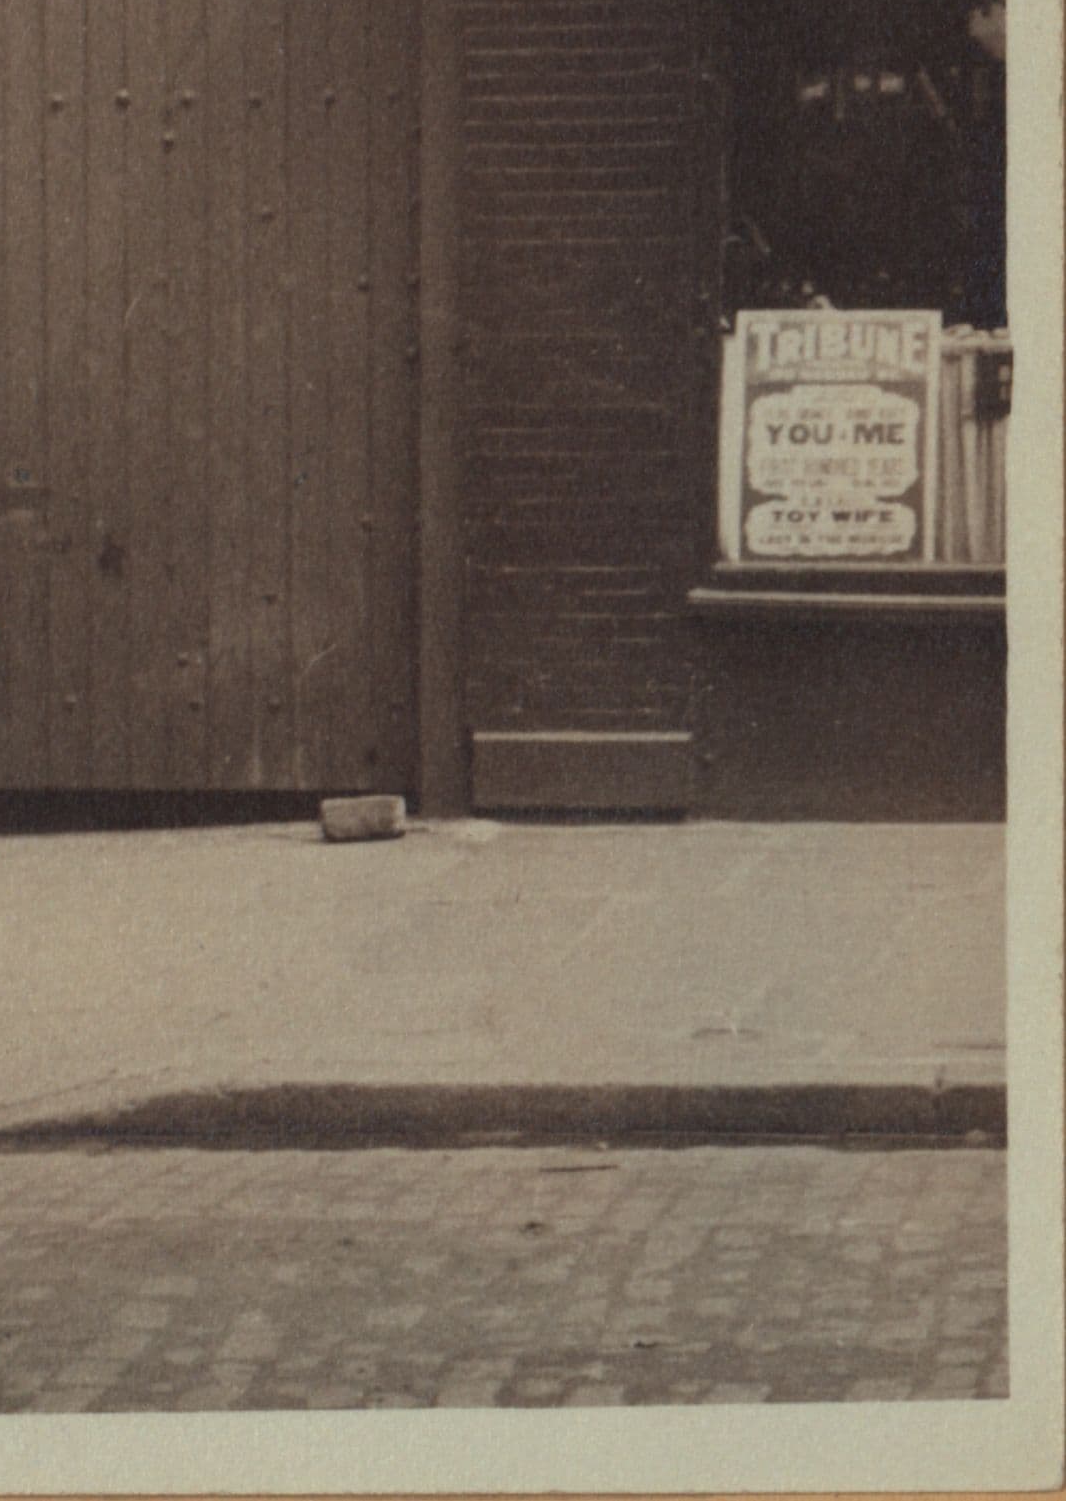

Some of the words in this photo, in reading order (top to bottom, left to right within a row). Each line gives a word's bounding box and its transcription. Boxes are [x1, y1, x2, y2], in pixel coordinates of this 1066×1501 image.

[748, 321, 927, 375] TRIBUNE
[765, 423, 834, 445] YOU
[852, 422, 906, 445] ME
[771, 510, 820, 523] TOY
[831, 509, 894, 523] WIFE
